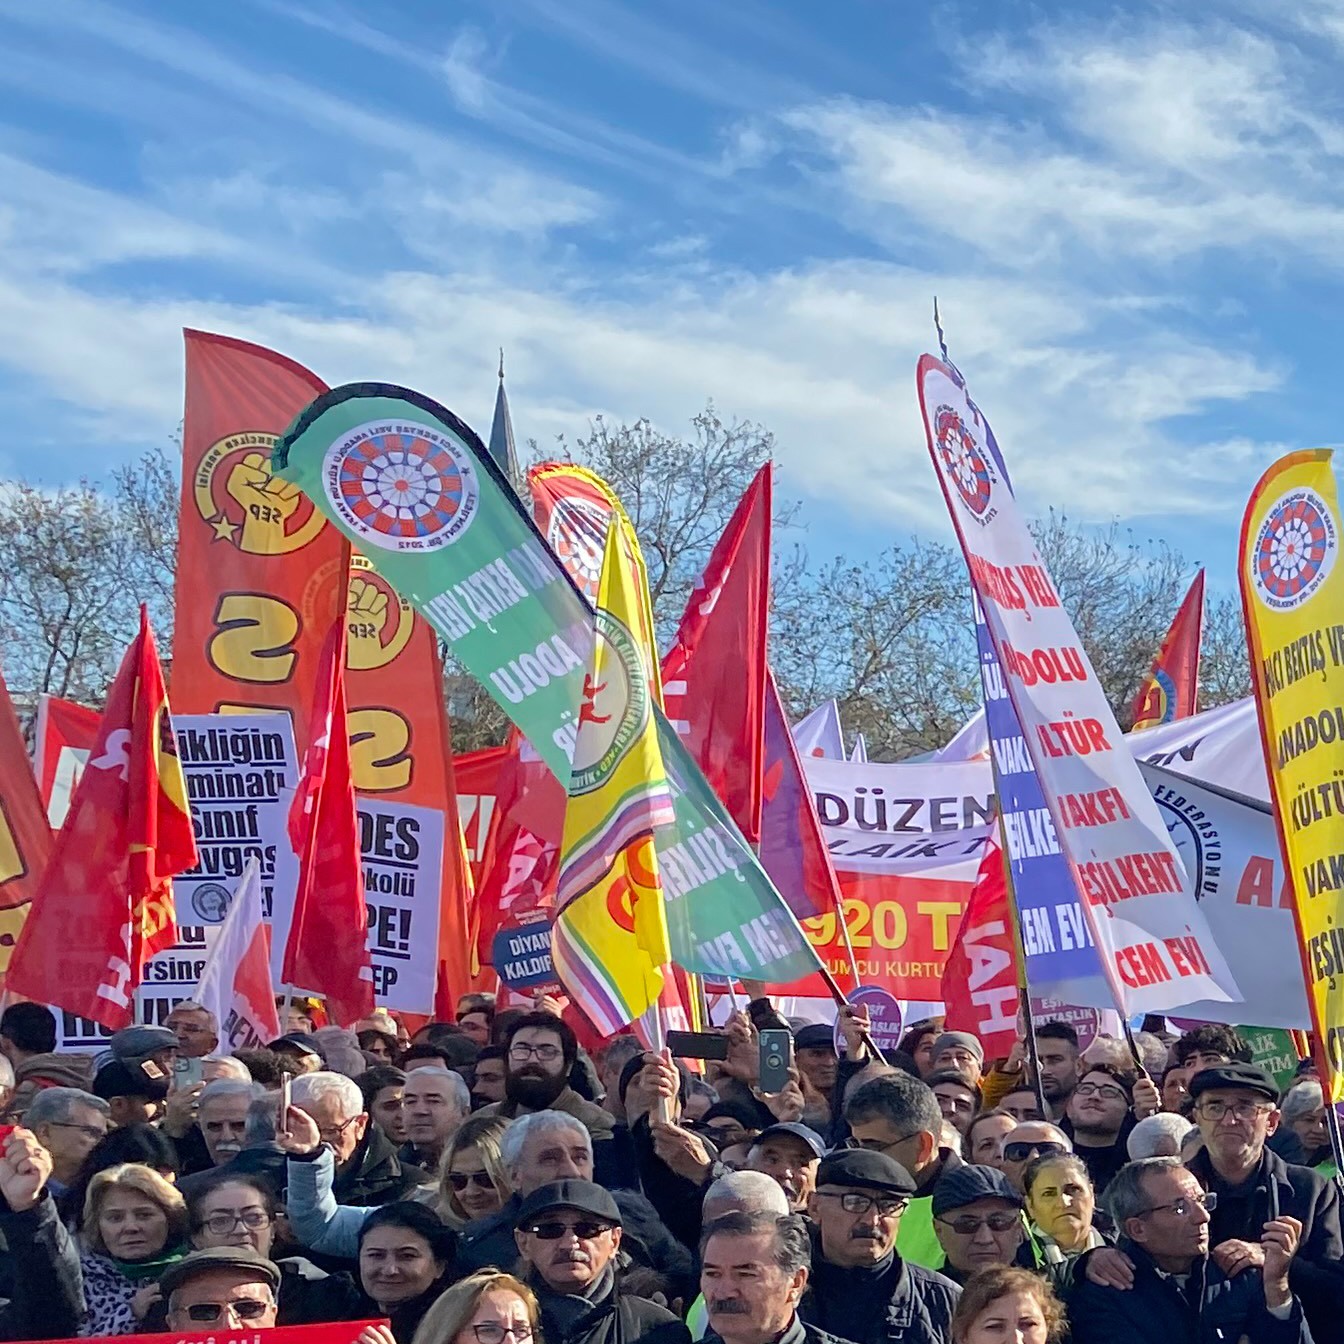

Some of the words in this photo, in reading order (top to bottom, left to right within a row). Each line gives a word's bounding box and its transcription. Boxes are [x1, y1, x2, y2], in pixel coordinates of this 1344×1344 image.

[1285, 627, 1327, 684] BEKTAŞ
[813, 786, 997, 833] DÜZEN
[1115, 940, 1173, 988] CEM
